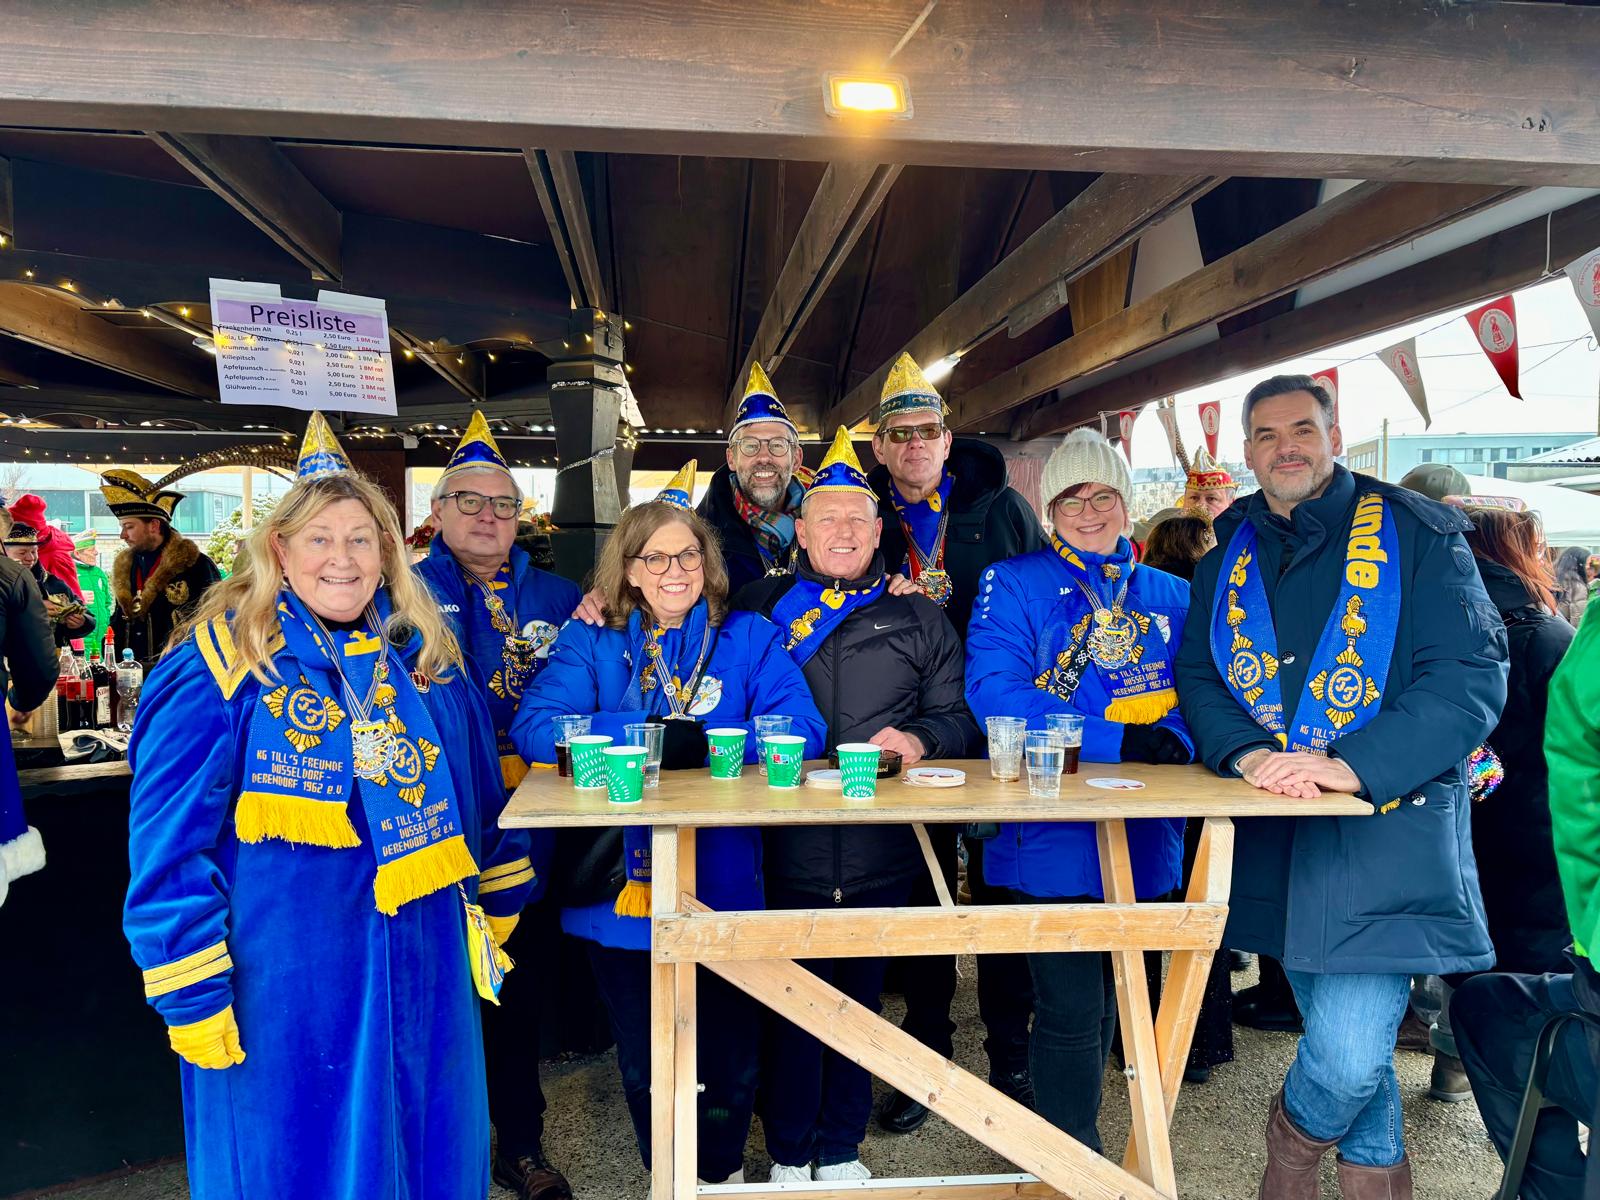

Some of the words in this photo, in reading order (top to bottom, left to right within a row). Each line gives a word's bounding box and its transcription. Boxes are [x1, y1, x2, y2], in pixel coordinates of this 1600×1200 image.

[250, 304, 356, 334] Preisliste
[1345, 492, 1388, 589] unde
[1300, 724, 1310, 735] KG
[256, 750, 268, 760] KG
[272, 750, 298, 765] TILL'S
[302, 756, 344, 772] FREUNDE
[252, 773, 298, 789] DERENDORF
[303, 781, 324, 793] 1962
[380, 818, 393, 832] KG
[395, 811, 422, 828] TILL'S
[382, 833, 429, 857] DERENDORF
